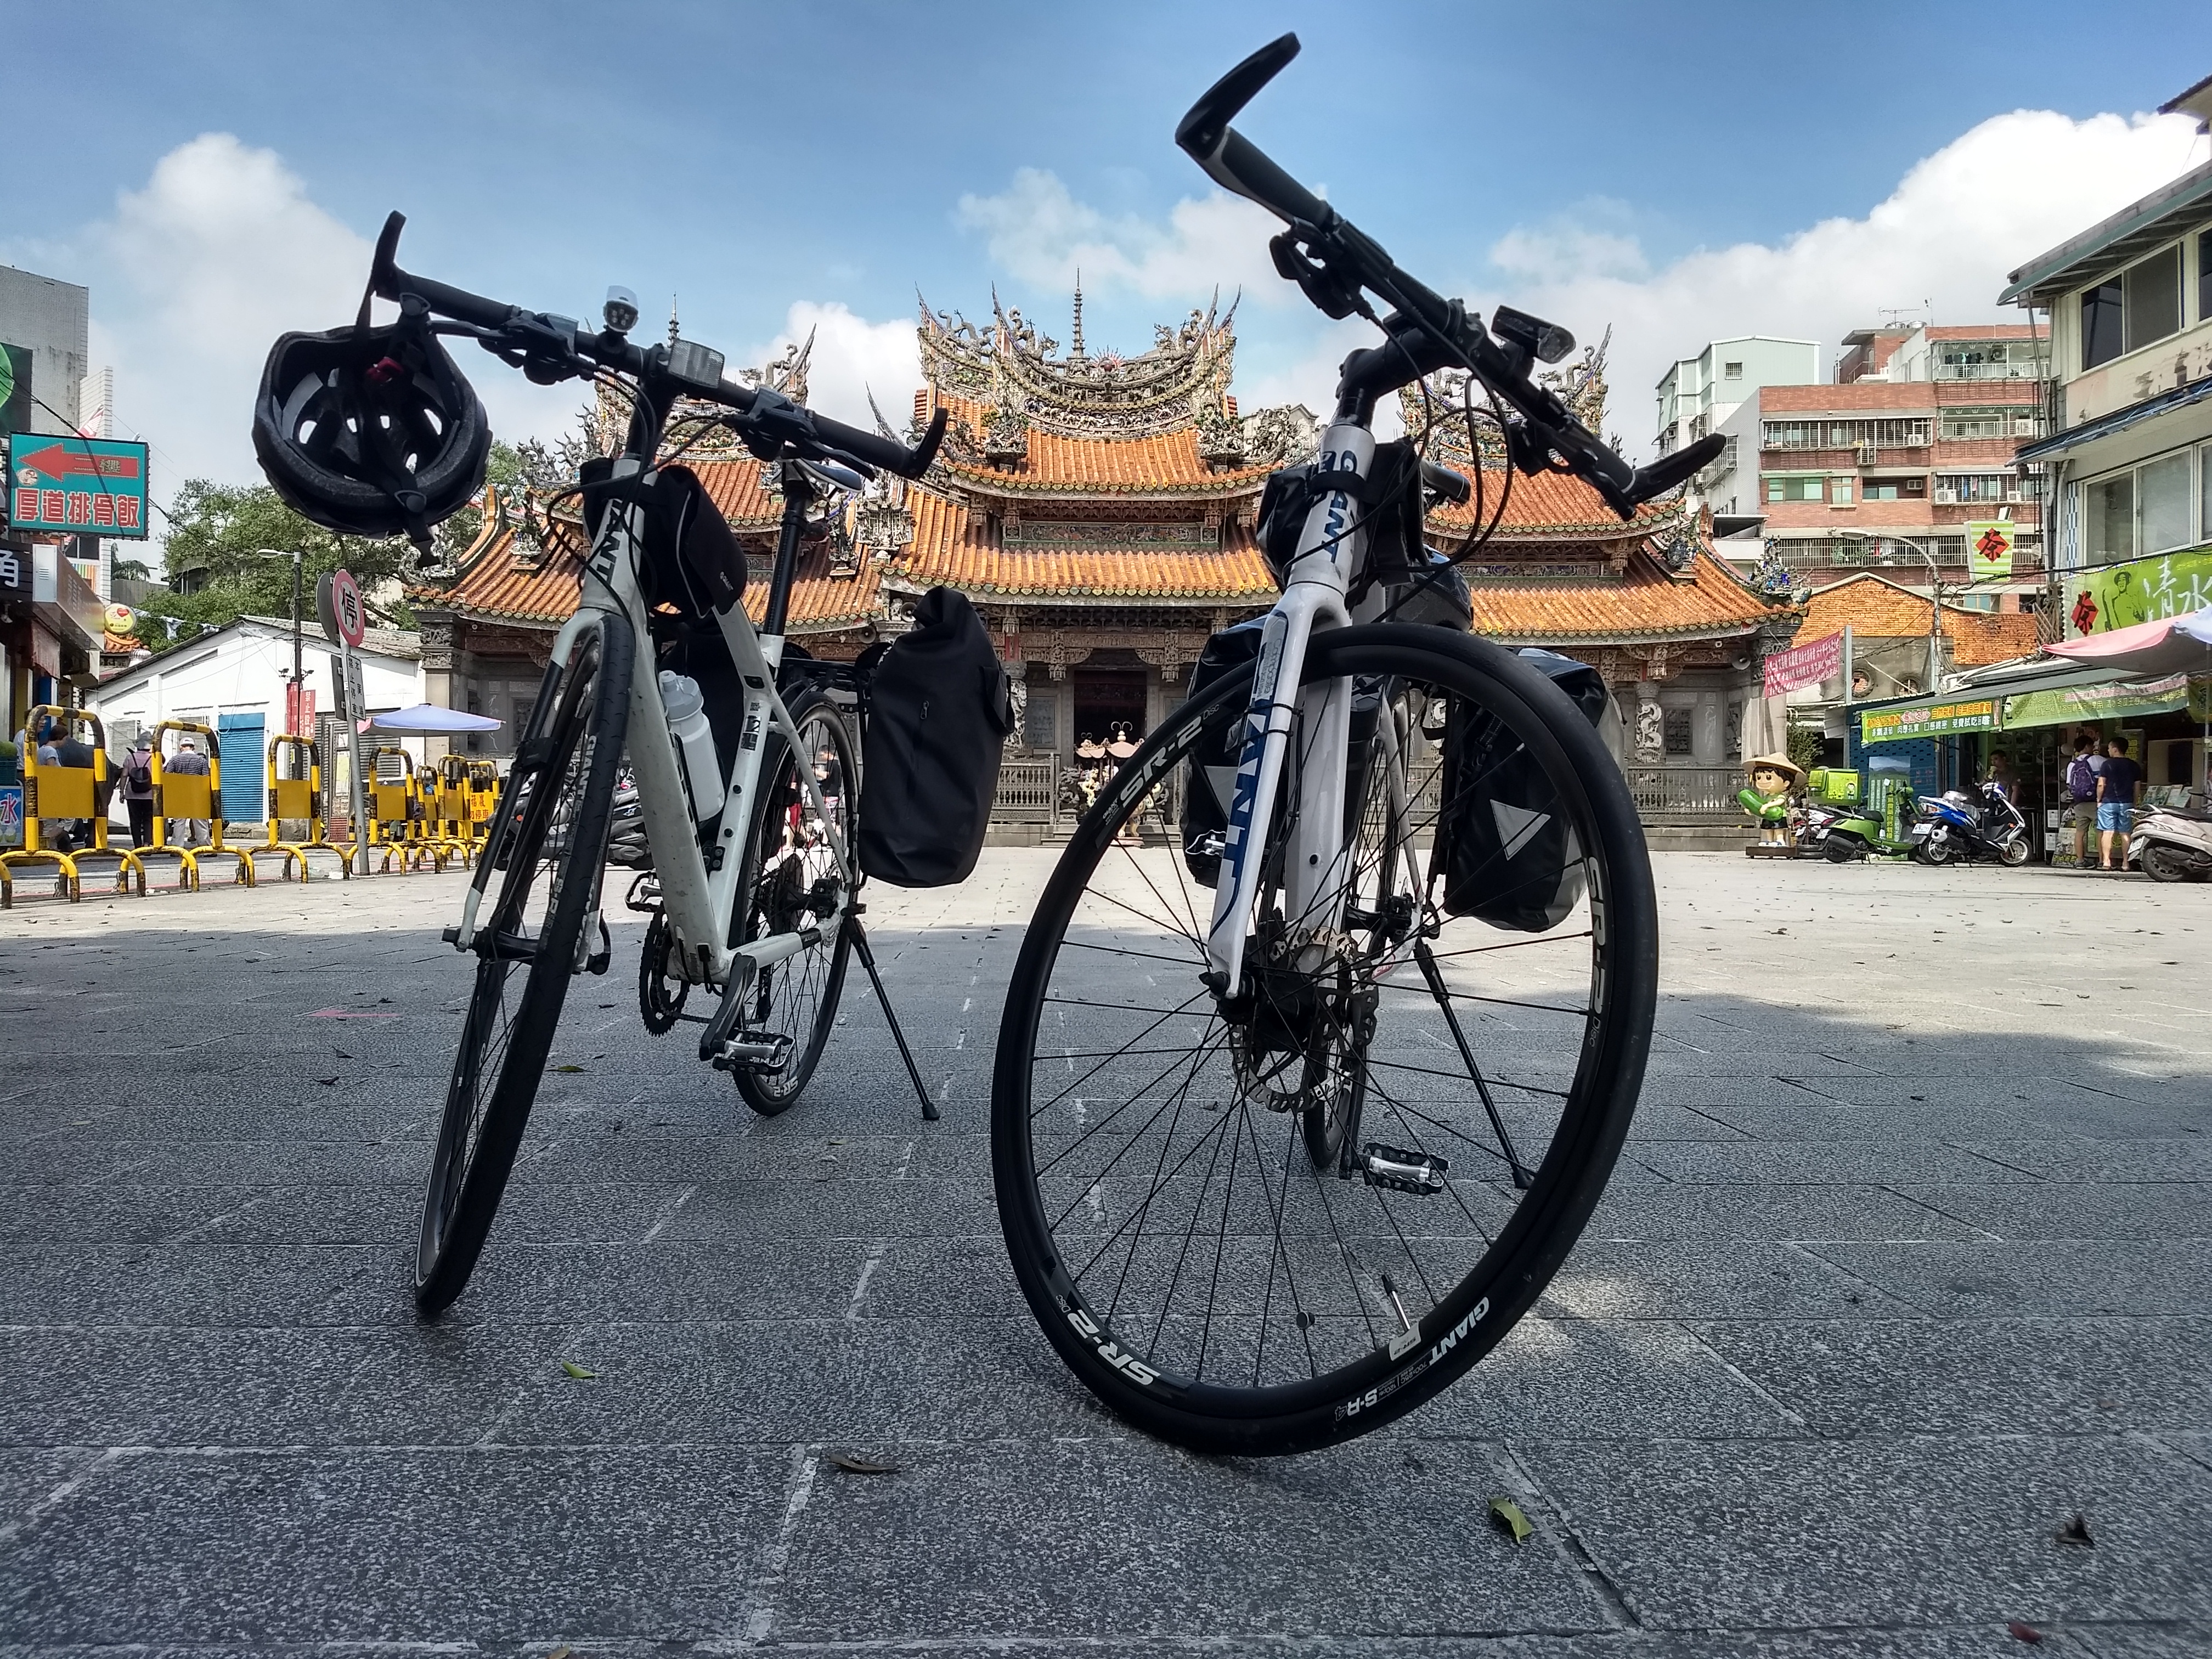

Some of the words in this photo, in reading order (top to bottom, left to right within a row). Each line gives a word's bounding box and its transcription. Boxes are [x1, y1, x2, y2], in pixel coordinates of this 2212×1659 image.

[14, 487, 140, 528] 厚道排骨飯
[342, 588, 358, 628] 停
[348, 657, 358, 714] 禁止停車
[575, 735, 597, 799] GIANT
[1120, 715, 1203, 808] SR-2
[0, 793, 18, 825] 水
[1588, 856, 1606, 1014] SR-2
[773, 1075, 798, 1097] SR-2
[1067, 1309, 1161, 1385] SR-2
[1429, 1296, 1490, 1365] GIANT
